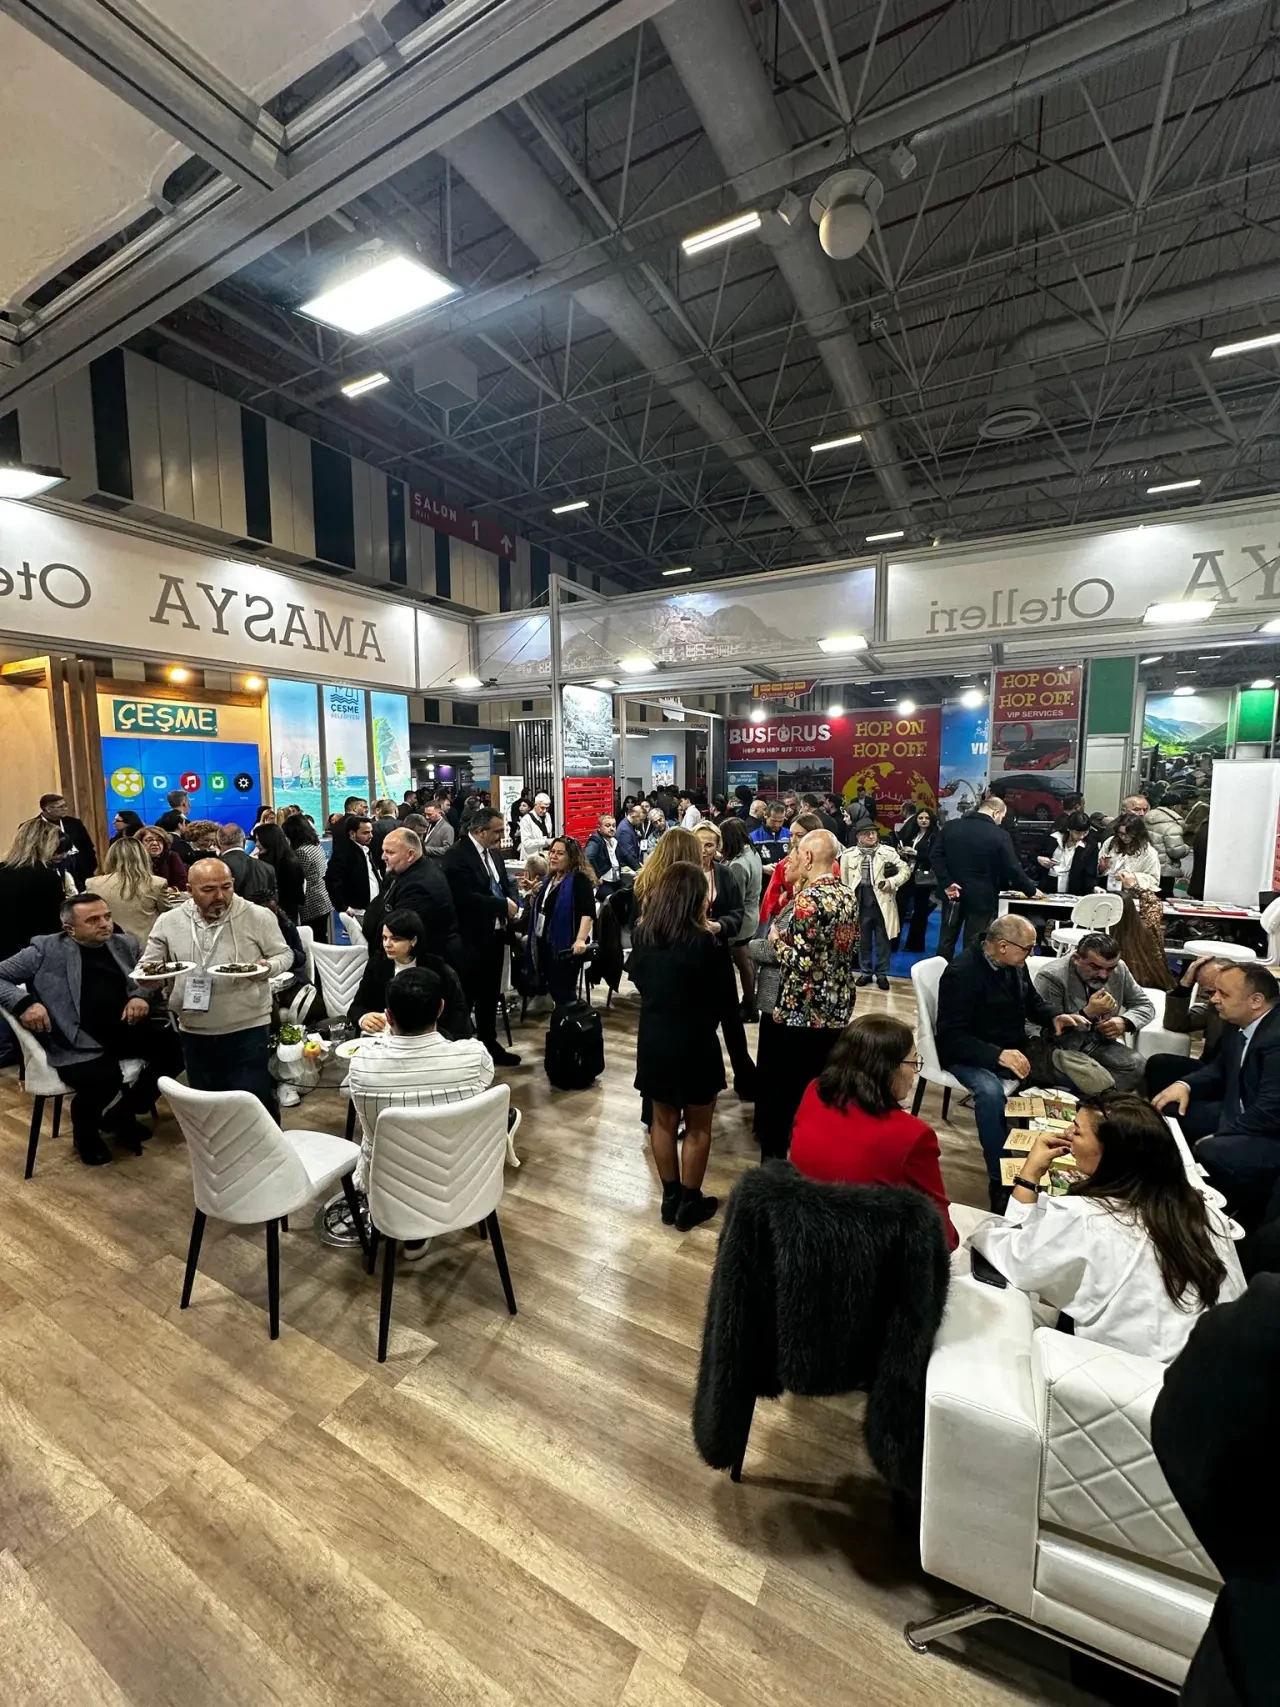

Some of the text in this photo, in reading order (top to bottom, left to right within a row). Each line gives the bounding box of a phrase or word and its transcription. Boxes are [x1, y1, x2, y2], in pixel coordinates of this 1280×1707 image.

[414, 492, 479, 541] SALON 1
[1001, 671, 1074, 689] HOP ON
[999, 690, 1074, 708] HOP OFF
[117, 703, 214, 732] ÇEŞME
[330, 703, 360, 714] ÇEŞME
[1022, 709, 1064, 718] SERVICES
[729, 724, 831, 744] BUSFORUS
[855, 719, 926, 737] HOP ON
[795, 745, 816, 753] TOURS
[852, 741, 928, 758] HOP OFF
